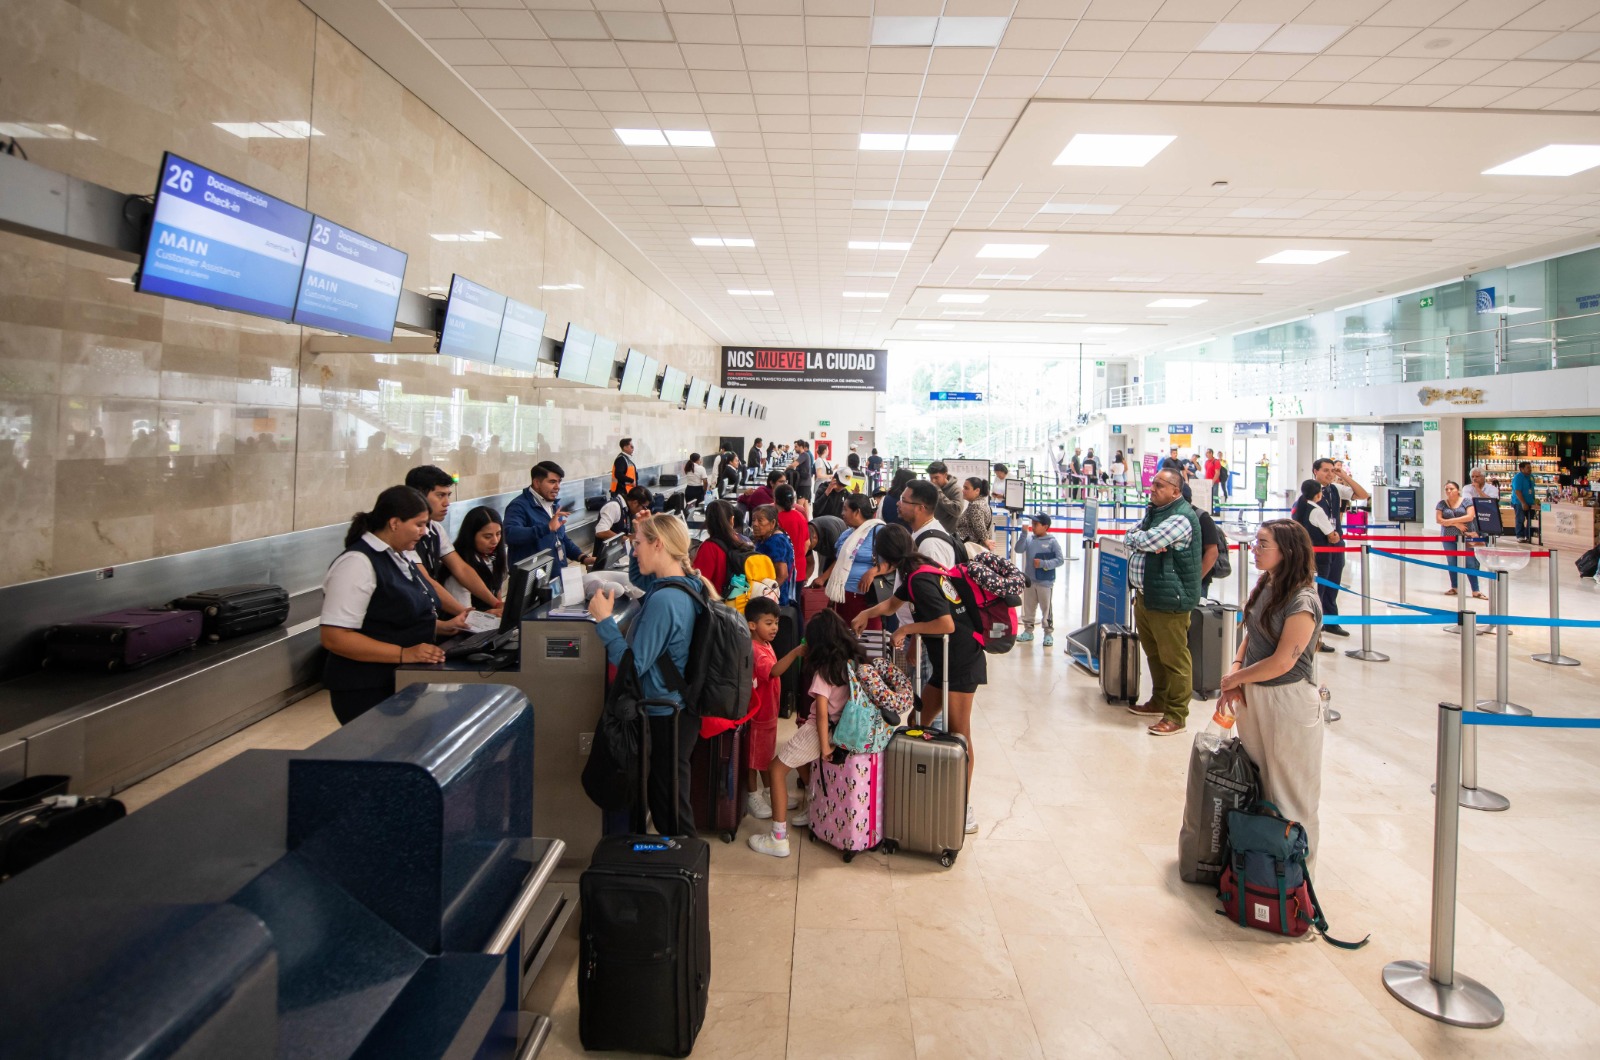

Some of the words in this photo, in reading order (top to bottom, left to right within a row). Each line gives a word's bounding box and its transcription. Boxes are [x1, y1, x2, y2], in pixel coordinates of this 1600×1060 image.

[166, 164, 194, 193] 26
[207, 175, 268, 208] Documentación
[204, 191, 241, 213] Check-in
[159, 230, 209, 256] MAIN
[313, 224, 331, 245] 25
[156, 248, 200, 267] Customer
[200, 260, 241, 279] Assistance
[307, 275, 338, 294] MAIN
[728, 351, 754, 368] NOS
[758, 352, 803, 368] MUEVE
[807, 352, 823, 370] LA
[826, 353, 876, 370] CIUDAD
[1211, 797, 1222, 853] patagonia
